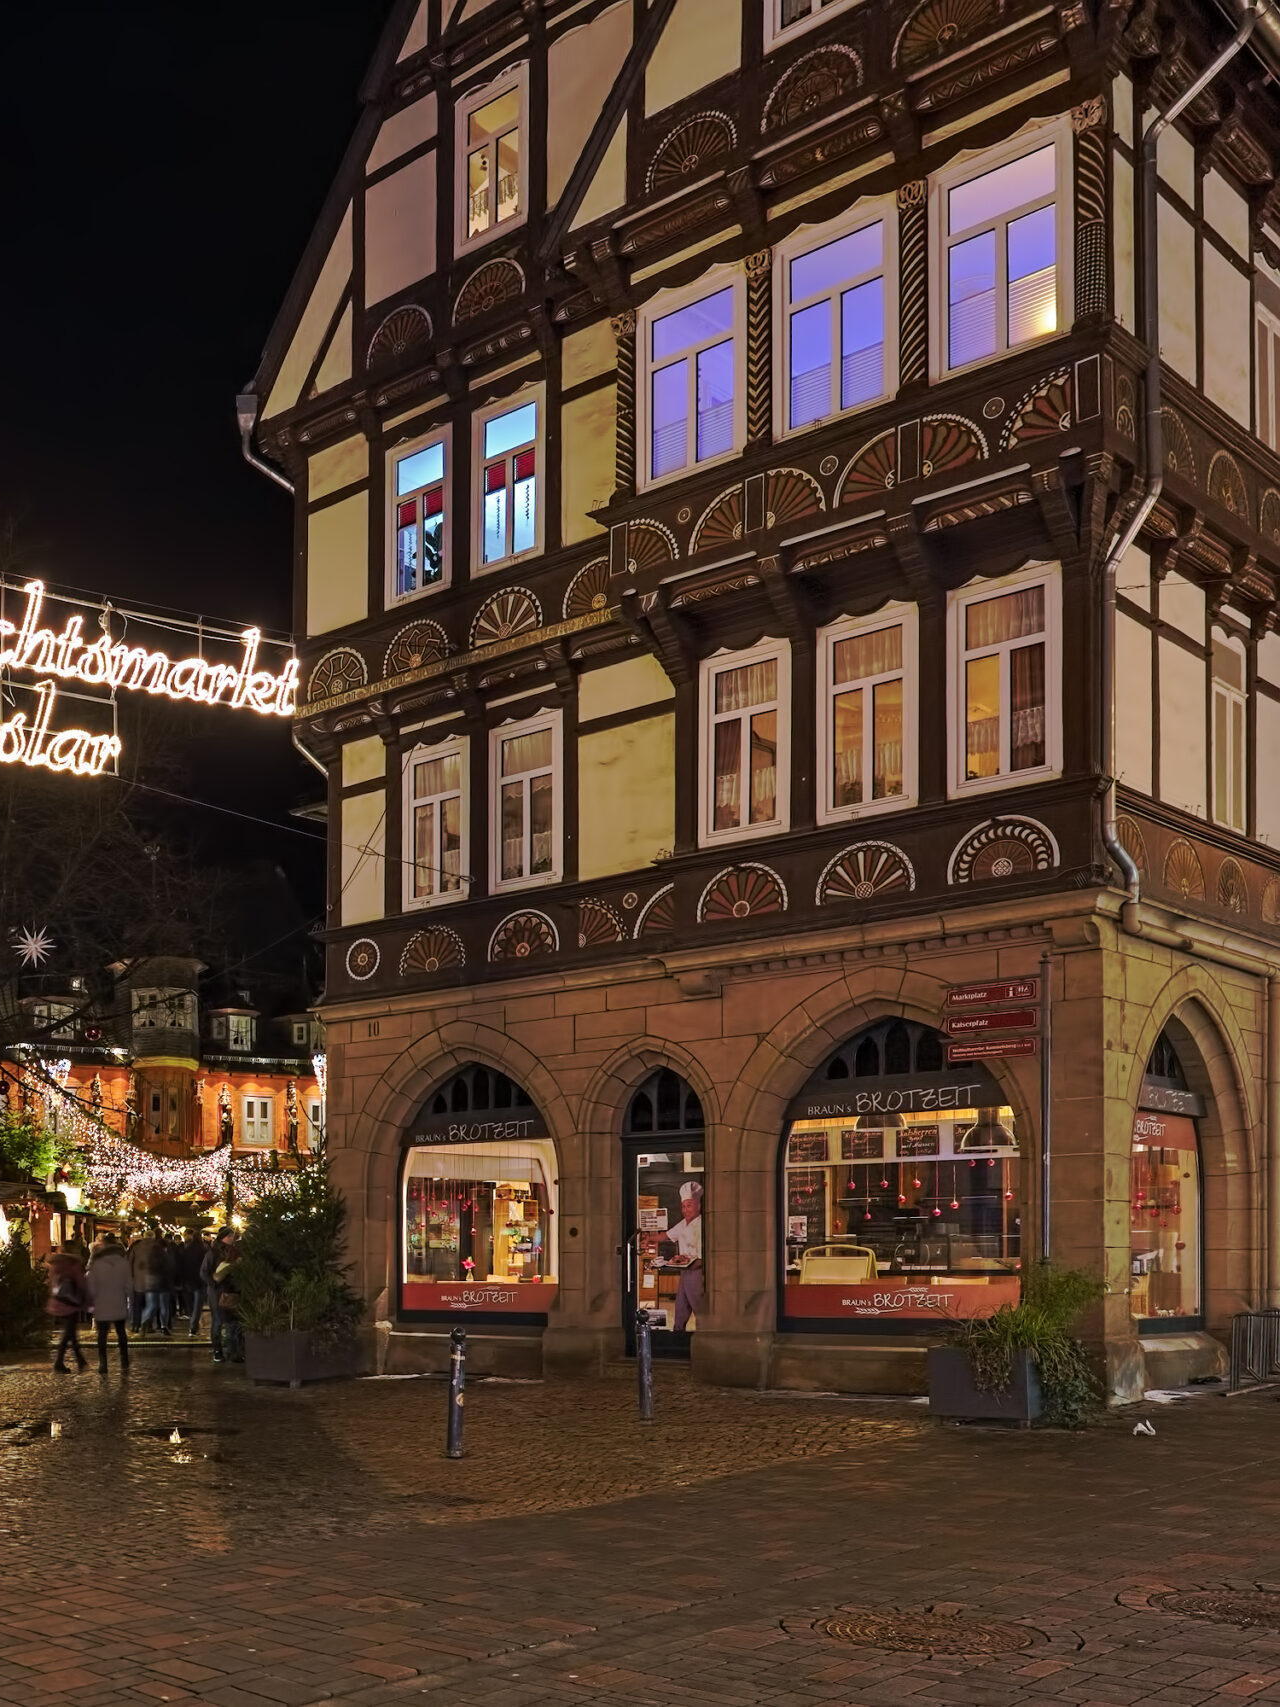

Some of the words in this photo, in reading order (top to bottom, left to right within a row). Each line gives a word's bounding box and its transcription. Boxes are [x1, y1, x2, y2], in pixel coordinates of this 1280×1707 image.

[951, 991, 988, 1001] Marktplatz
[368, 1020, 380, 1037] 10
[951, 1019, 989, 1029] Kaiserpfalz
[855, 1084, 981, 1113] BROTZEIT
[448, 1119, 534, 1142] BROTZEIT
[462, 1290, 518, 1303] BROTZEIT
[873, 1293, 954, 1307] BROTZEIT
